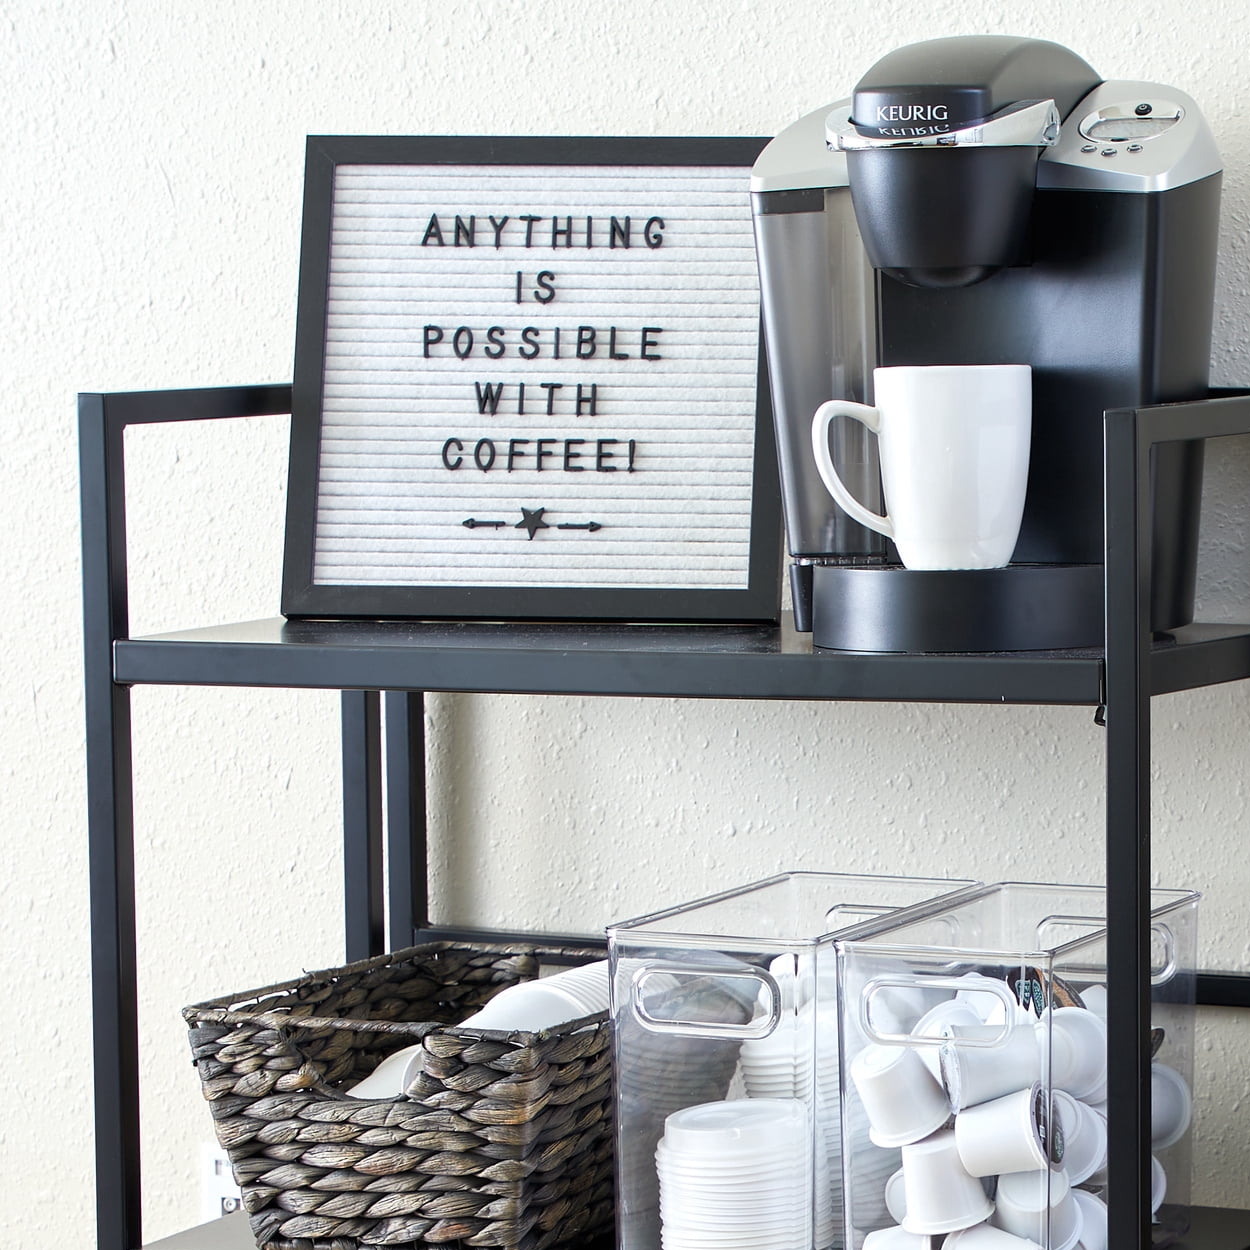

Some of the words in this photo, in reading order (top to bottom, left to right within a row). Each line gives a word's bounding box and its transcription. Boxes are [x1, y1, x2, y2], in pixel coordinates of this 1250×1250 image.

[876, 104, 948, 121] KEURIG
[421, 213, 665, 250] ANYTHING
[515, 271, 556, 305] IS
[423, 325, 663, 361] POSSIBLE
[475, 381, 599, 417] WITH
[441, 437, 637, 473] COFFEE!
